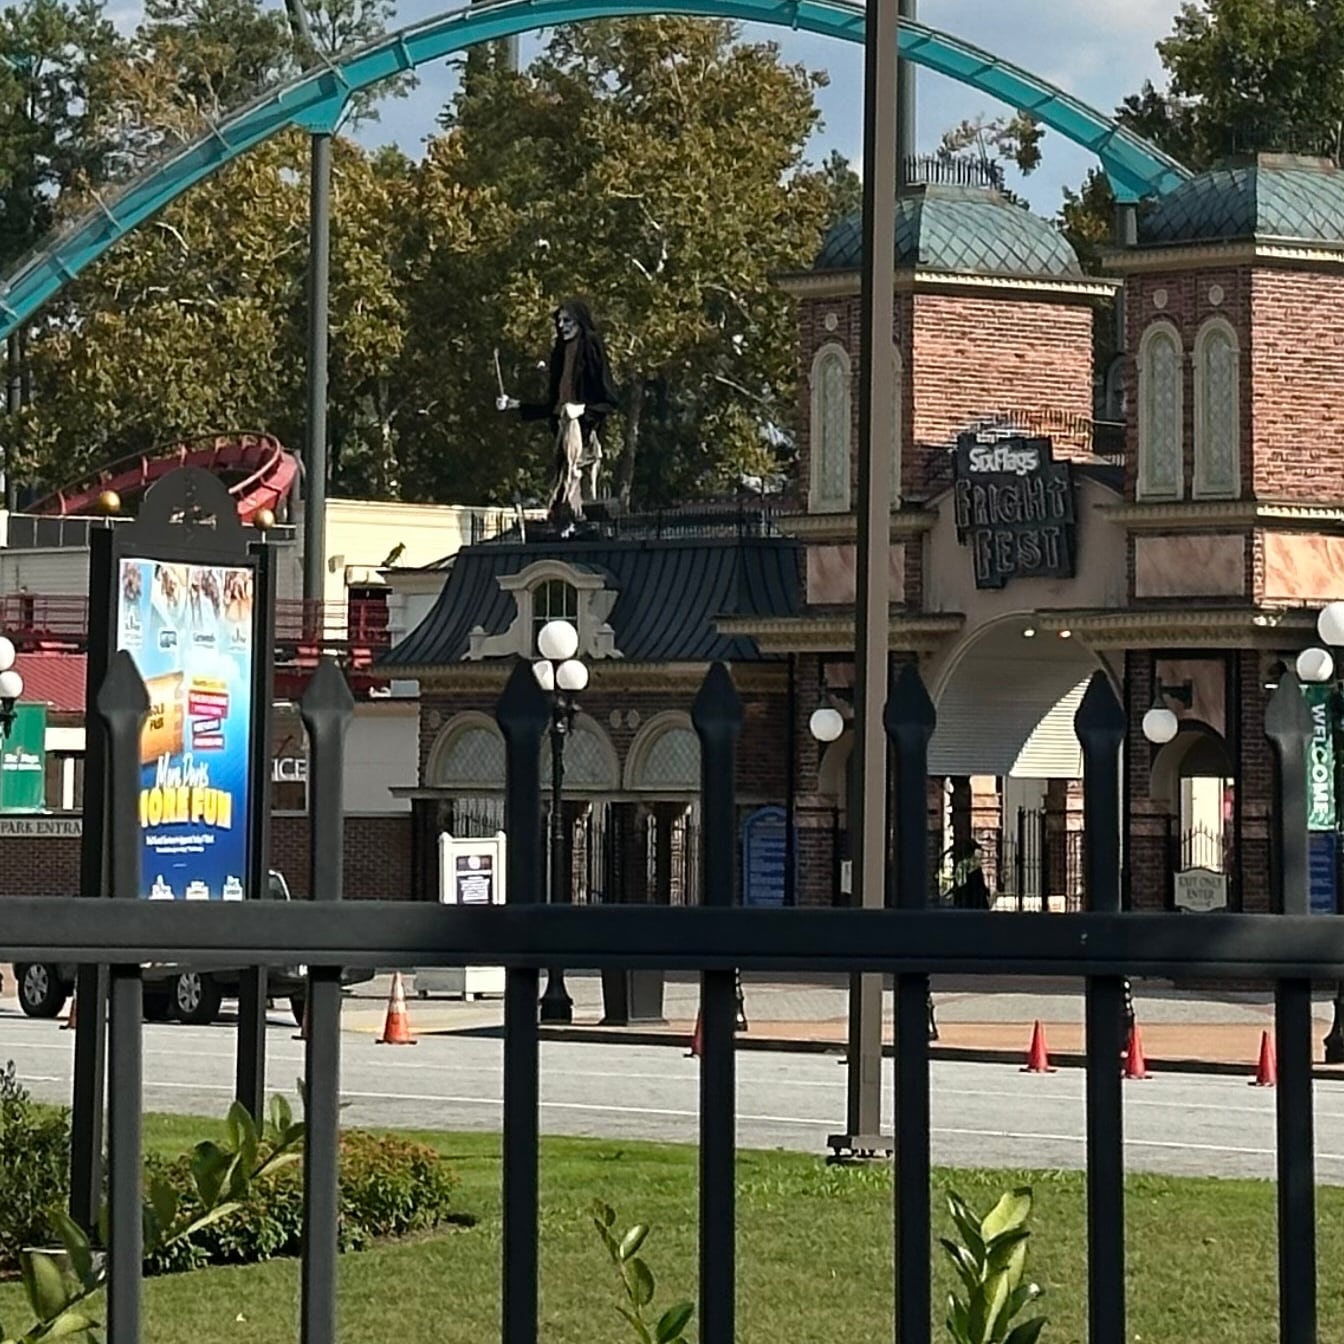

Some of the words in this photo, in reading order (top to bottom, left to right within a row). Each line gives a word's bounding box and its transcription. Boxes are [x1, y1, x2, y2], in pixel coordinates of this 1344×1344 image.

[956, 476, 1068, 528] FRIGHT
[976, 527, 1060, 580] FEST
[155, 751, 182, 789] More
[272, 758, 307, 782] ICE
[1311, 703, 1329, 816] WELCOME
[0, 821, 34, 834] PARK
[36, 821, 82, 834] ENTRA
[191, 787, 232, 829] FUN
